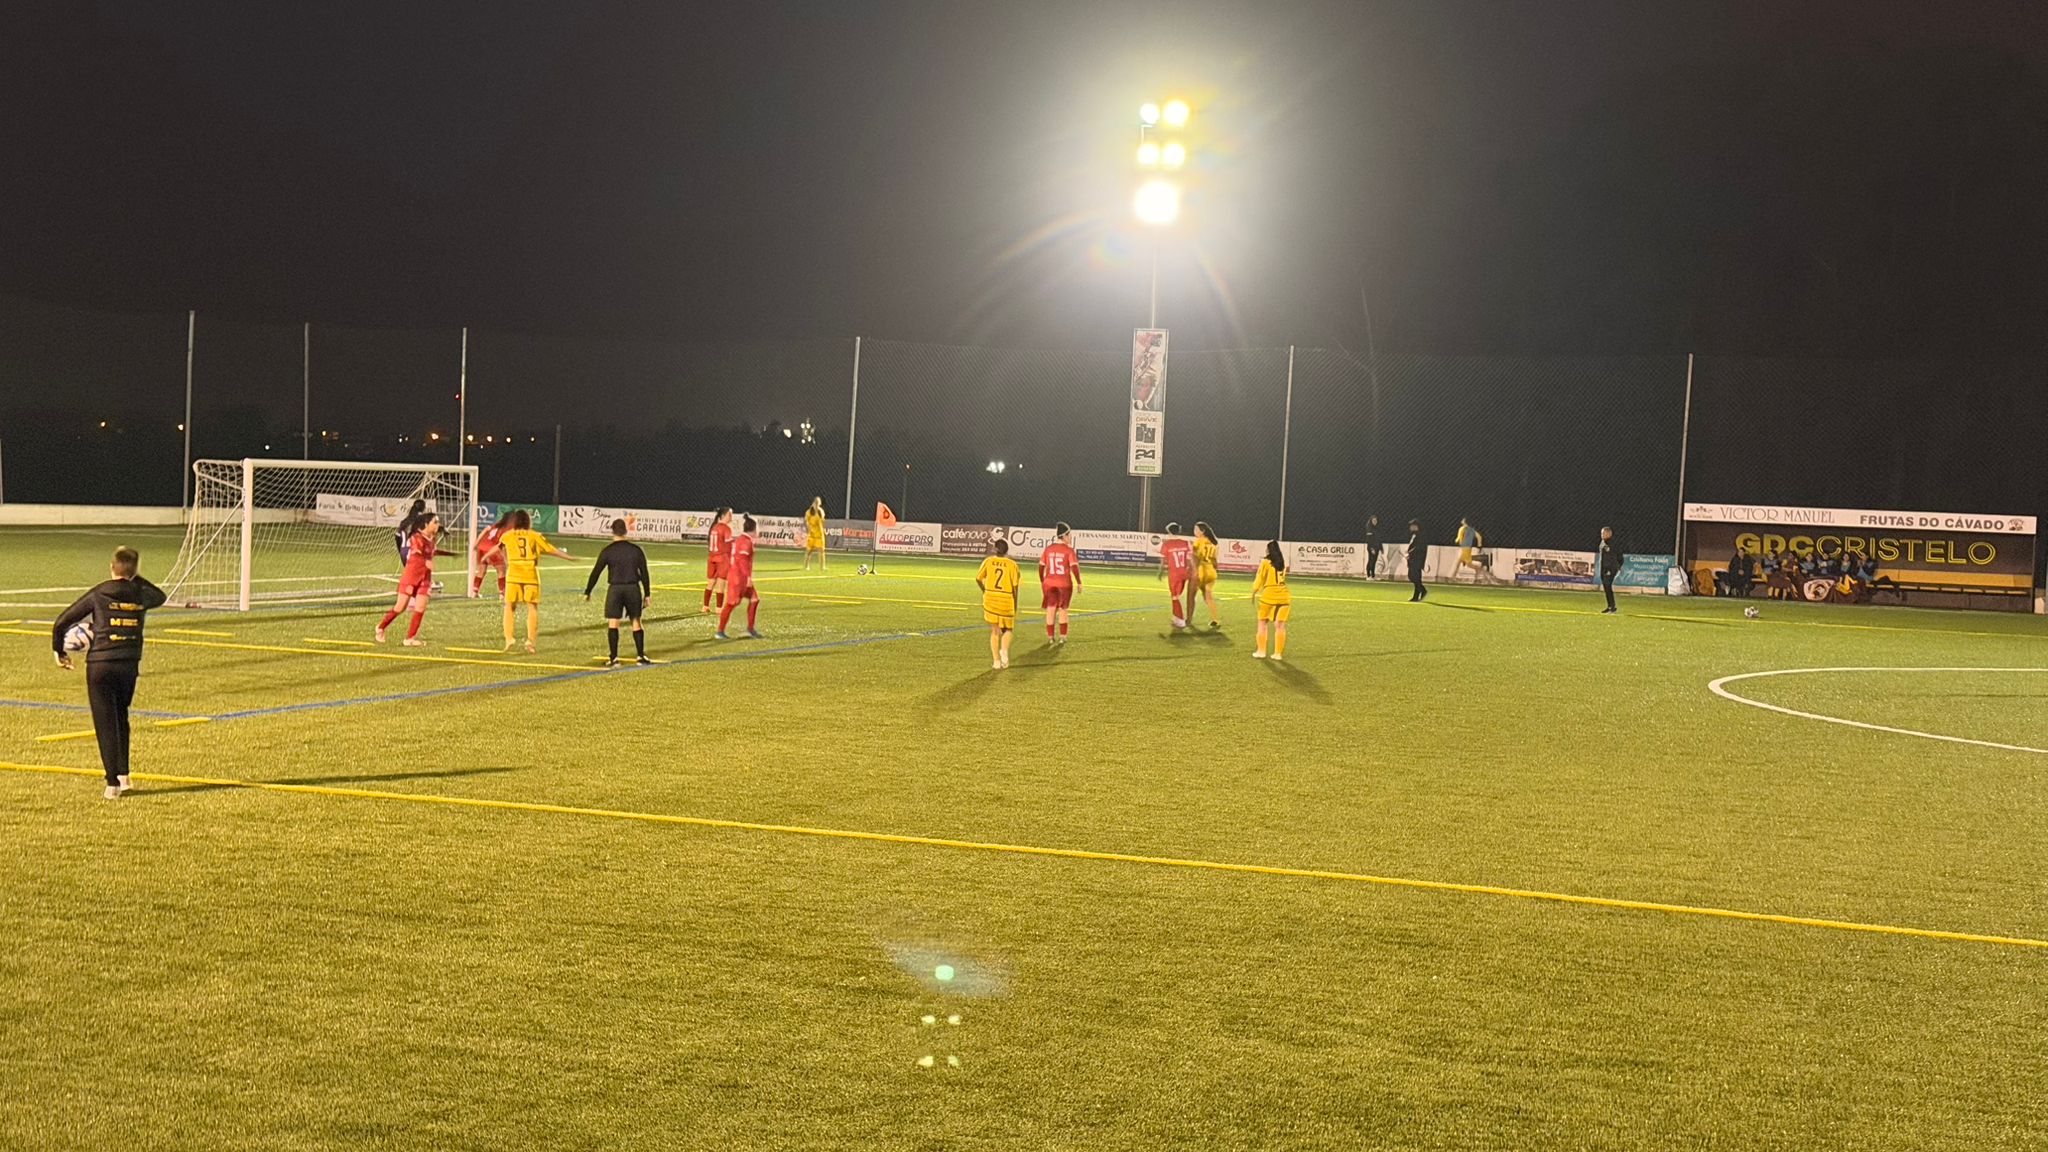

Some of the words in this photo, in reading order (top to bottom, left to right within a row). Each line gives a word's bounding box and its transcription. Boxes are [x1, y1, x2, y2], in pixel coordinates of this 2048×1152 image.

[1719, 506, 1779, 522] VICTOR
[1783, 510, 1836, 524] MANUEL
[1859, 514, 1914, 527] FRUTAS
[1918, 517, 1940, 528] DO
[1944, 515, 2005, 531] CÁVADO
[636, 523, 681, 533] CARLINHA
[518, 537, 527, 558] 3
[709, 534, 719, 552] 11
[1306, 546, 1328, 554] CASA
[1049, 557, 1065, 575] 15
[994, 568, 1004, 590] 2
